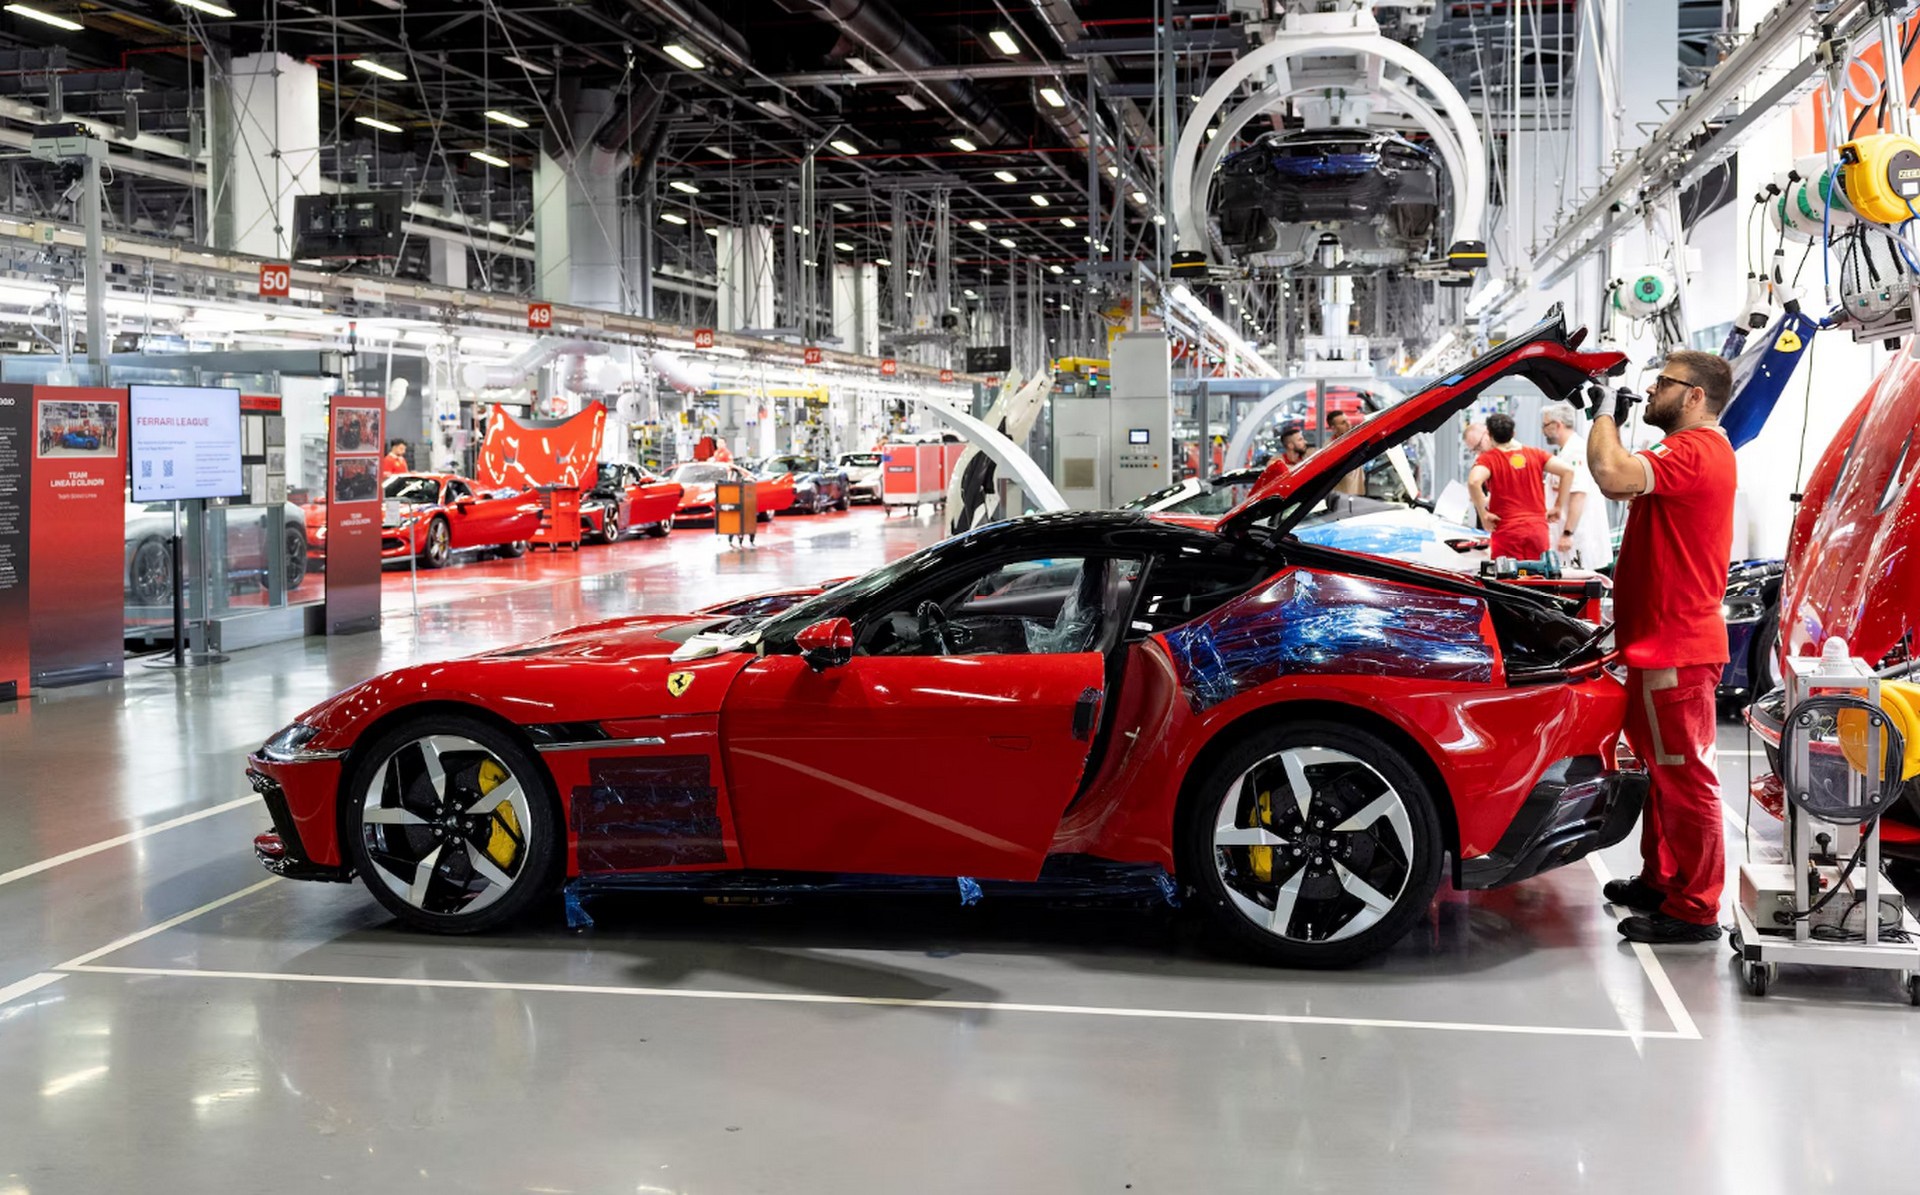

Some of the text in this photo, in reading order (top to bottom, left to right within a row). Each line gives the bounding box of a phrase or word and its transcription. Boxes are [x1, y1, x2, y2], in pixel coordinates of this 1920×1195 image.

[263, 271, 288, 290] 50
[530, 308, 549, 323] 49
[696, 333, 712, 345] 48
[805, 351, 820, 361] 47
[882, 363, 895, 372] 46
[137, 417, 209, 426] FERRARI LEAGUE
[68, 471, 88, 479] TEAM
